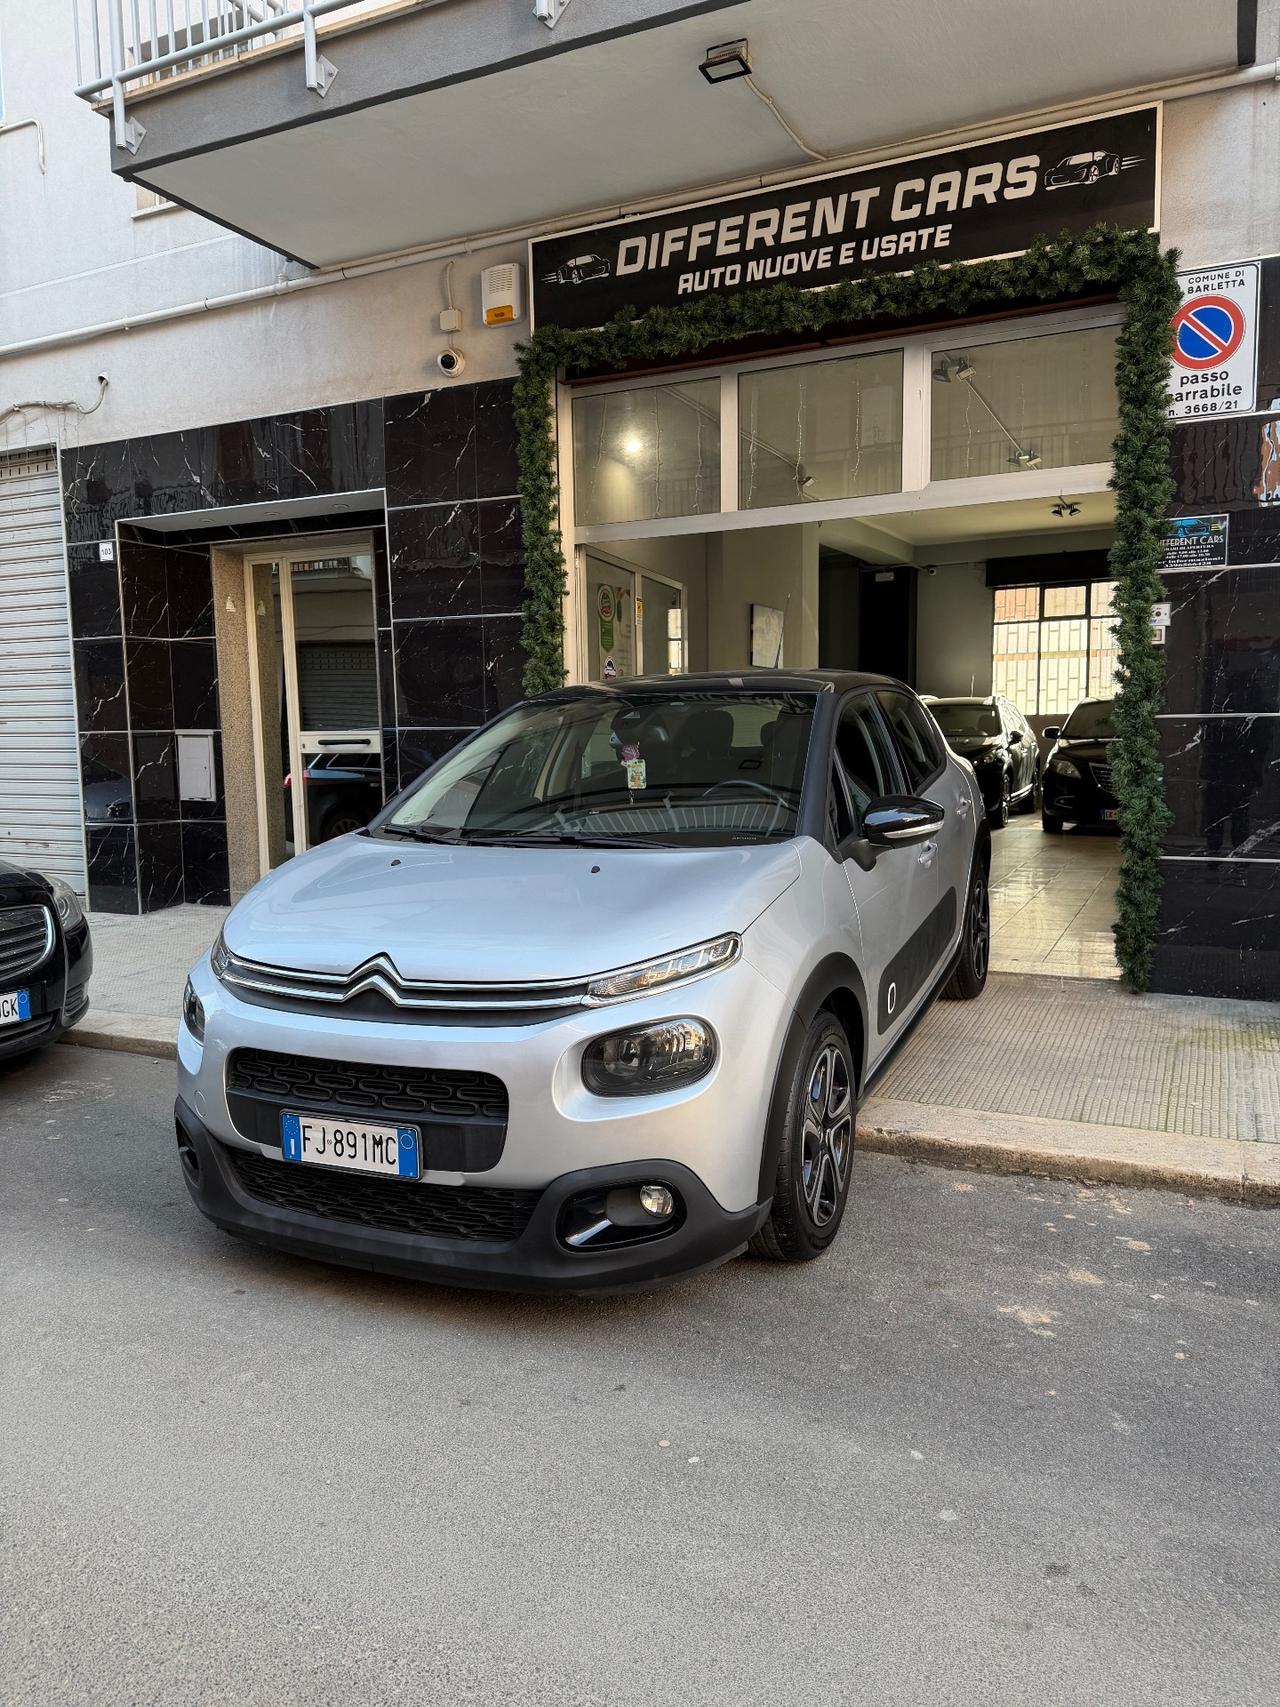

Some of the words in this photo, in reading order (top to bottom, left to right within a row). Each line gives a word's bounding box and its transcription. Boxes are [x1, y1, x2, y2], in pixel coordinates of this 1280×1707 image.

[615, 186, 881, 276] DIFFERENT
[890, 154, 1042, 223] CARS
[677, 264, 741, 295] AUTO
[746, 245, 834, 283] NUOVE
[838, 241, 856, 266] E
[860, 222, 953, 262] USATE
[1188, 271, 1230, 285] COMUNE
[1235, 269, 1245, 278] DI
[1187, 278, 1246, 294] BARLETTA
[1180, 370, 1229, 387] passo
[1169, 383, 1243, 402] arrabile
[1168, 408, 1178, 416] n.
[1184, 400, 1238, 415] 3668/21
[1200, 535, 1224, 544] CARS
[0, 998, 18, 1018] GK
